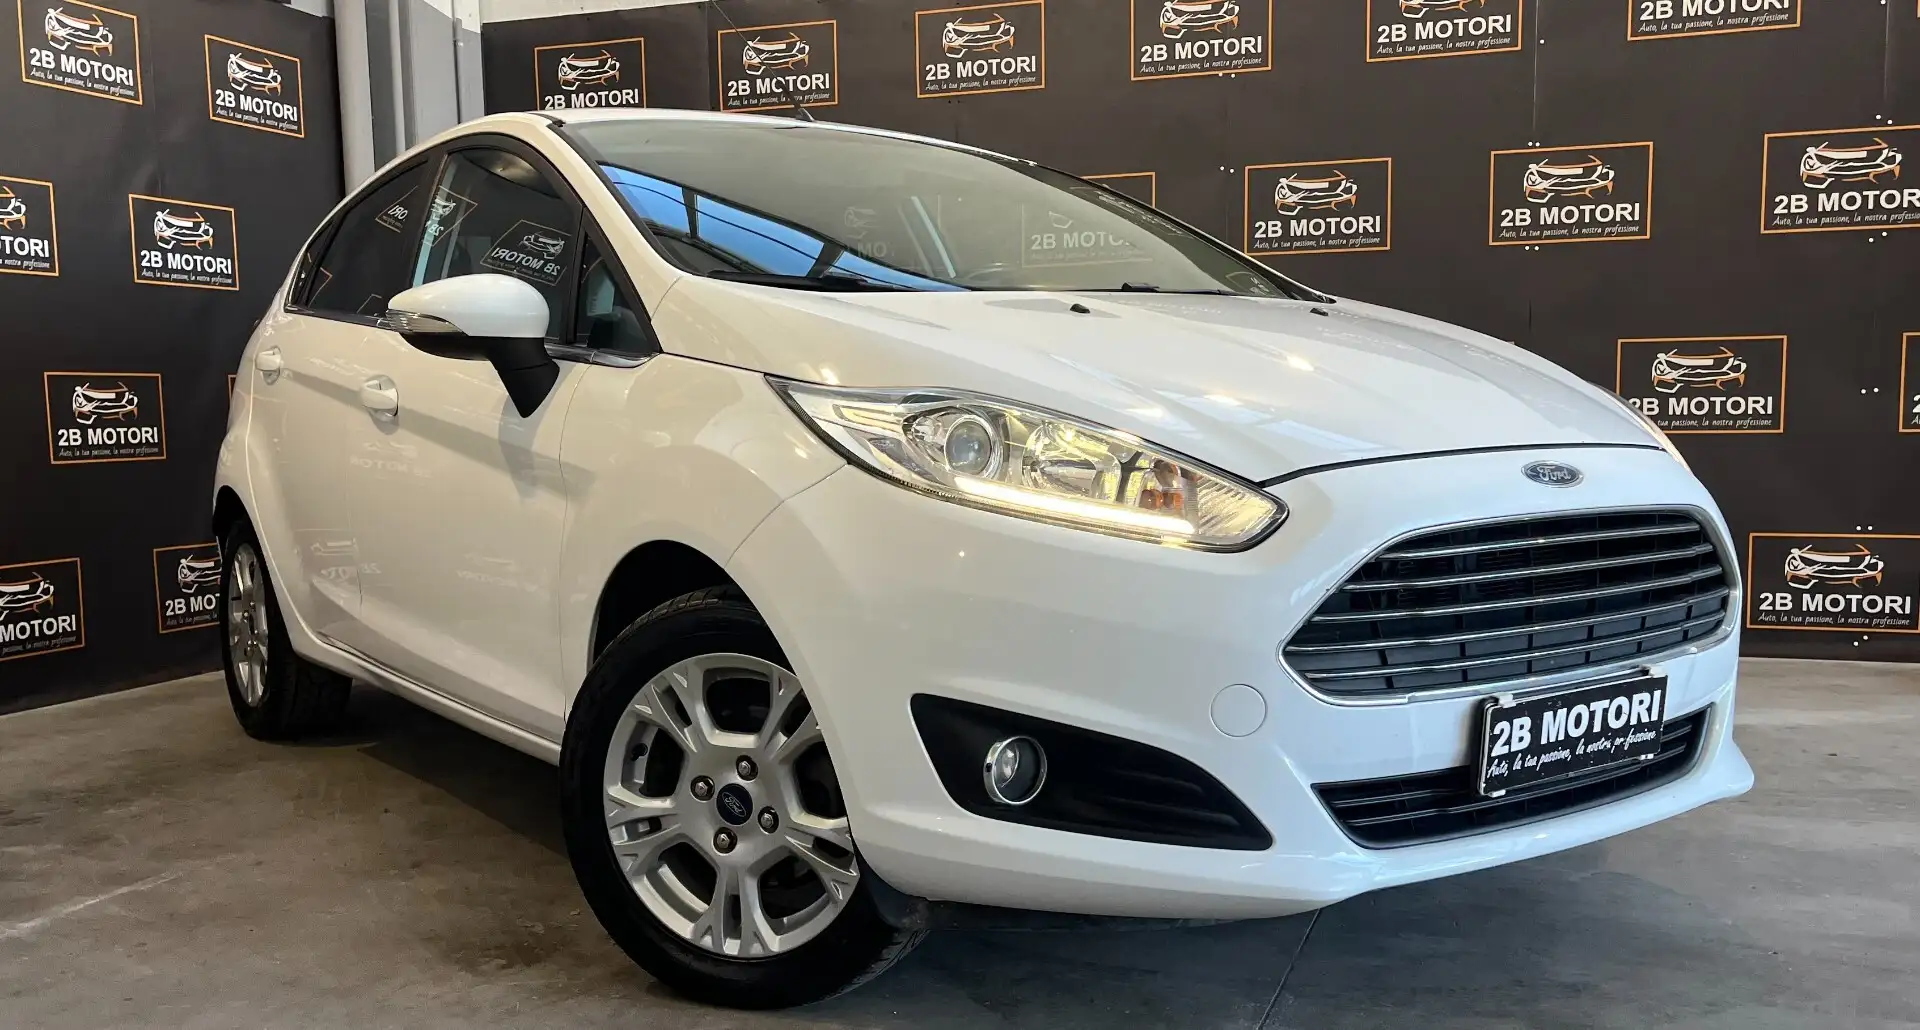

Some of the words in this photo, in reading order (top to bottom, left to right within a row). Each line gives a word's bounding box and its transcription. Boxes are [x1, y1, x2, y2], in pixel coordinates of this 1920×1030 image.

[1640, 0, 1673, 21] 2B
[1377, 24, 1407, 43] 2B
[1415, 15, 1511, 40] MOTORI
[1638, 23, 1657, 32] Auto,
[1661, 21, 1668, 30] la
[1685, 20, 1713, 31] passione,
[1717, 16, 1724, 25] la
[1751, 13, 1789, 26] professione
[1141, 44, 1168, 63] 2B
[1175, 36, 1262, 60] MOTORI
[1376, 45, 1393, 54] Auto,
[1396, 44, 1402, 52] la
[1418, 43, 1443, 53] passione,
[1446, 39, 1453, 48] la
[1477, 37, 1511, 49] professione
[30, 48, 55, 69] 2B
[61, 54, 133, 86] MOTORI
[926, 63, 950, 81] 2B
[957, 56, 1036, 78] MOTORI
[1140, 65, 1155, 73] Auto,
[1158, 63, 1164, 71] la
[1178, 63, 1201, 72] passione,
[1203, 59, 1209, 68] la
[1231, 57, 1262, 69] professione
[728, 80, 751, 96] 2B
[756, 73, 829, 94] MOTORI
[941, 81, 947, 89] la
[983, 78, 988, 86] la
[216, 89, 236, 108] 2B
[240, 94, 297, 121] MOTORI
[545, 95, 566, 111] 2B
[571, 89, 639, 109] MOTORI
[1774, 194, 1808, 214] 2B
[1818, 188, 1920, 212] MOTOR
[1500, 208, 1531, 227] 2B
[1540, 203, 1640, 225] MOTORI
[1772, 216, 1791, 226] Auto,
[1795, 215, 1803, 224] la
[1820, 216, 1850, 226] passione,
[1854, 212, 1861, 222] la
[1889, 211, 1920, 223] professio
[1254, 221, 1282, 238] 2B
[1290, 216, 1380, 236] MOTORI
[1499, 229, 1516, 238] Auto,
[1520, 228, 1526, 236] la
[1542, 229, 1569, 238] passione,
[1572, 225, 1579, 234] la
[1604, 224, 1639, 236] professione
[0, 236, 50, 258] TORI
[1031, 234, 1056, 250] 2B
[1253, 240, 1269, 249] Auto,
[1293, 241, 1316, 249] passione,
[1319, 237, 1325, 246] la
[1348, 236, 1380, 247] professione
[141, 250, 163, 267] 2B
[168, 253, 232, 274] MOTORI
[1668, 396, 1773, 415] MOTORI
[1671, 420, 1698, 428] passione,
[1702, 417, 1709, 426] la
[1735, 417, 1772, 429] professione
[58, 429, 82, 446] 2B
[88, 427, 158, 445] MOTORI
[1536, 464, 1572, 481] Ford
[165, 598, 186, 616] 2B
[1759, 592, 1793, 611] 2B
[1802, 594, 1911, 614] MOTORI
[0, 614, 76, 643] MOTORI
[1758, 613, 1776, 622] Auto,
[1780, 613, 1787, 621] la
[1837, 614, 1844, 623] la
[1872, 616, 1910, 628] professione
[1491, 717, 1531, 757] 2B
[1541, 690, 1662, 745] MOTORI
[1513, 753, 1522, 770] la
[1576, 738, 1585, 754] la
